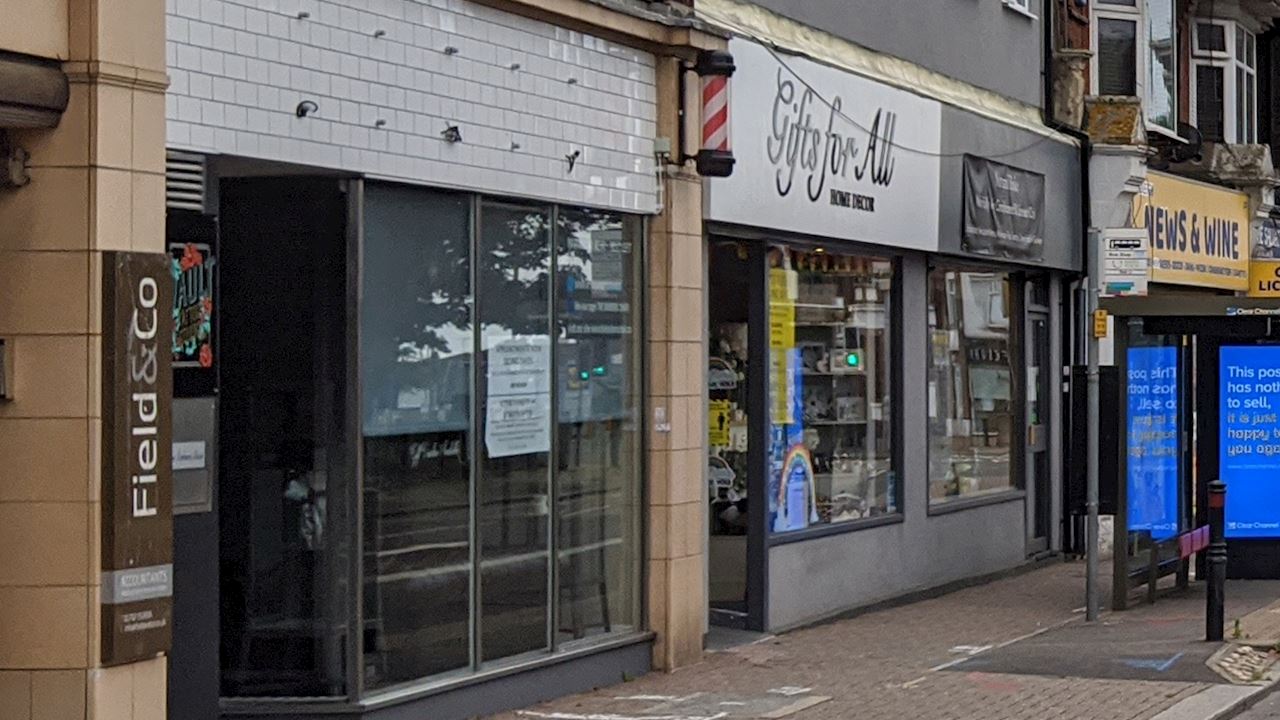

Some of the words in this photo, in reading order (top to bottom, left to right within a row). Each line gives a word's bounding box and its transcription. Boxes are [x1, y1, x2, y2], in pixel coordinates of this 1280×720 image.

[767, 67, 820, 196] Gifts
[807, 96, 858, 202] for
[855, 107, 896, 187] All
[830, 189, 851, 208] HOME
[852, 193, 875, 212] DECOR
[1144, 204, 1187, 252] NEWS
[1191, 213, 1200, 254] &
[1204, 216, 1239, 260] WINE
[1227, 366, 1254, 378] This
[1227, 381, 1252, 393] has
[1227, 397, 1240, 409] to
[1244, 396, 1272, 410] sell,
[1227, 412, 1235, 423] it
[1239, 412, 1249, 423] is
[1252, 412, 1277, 426] just
[1227, 427, 1269, 440] happy
[1227, 445, 1252, 457] you
